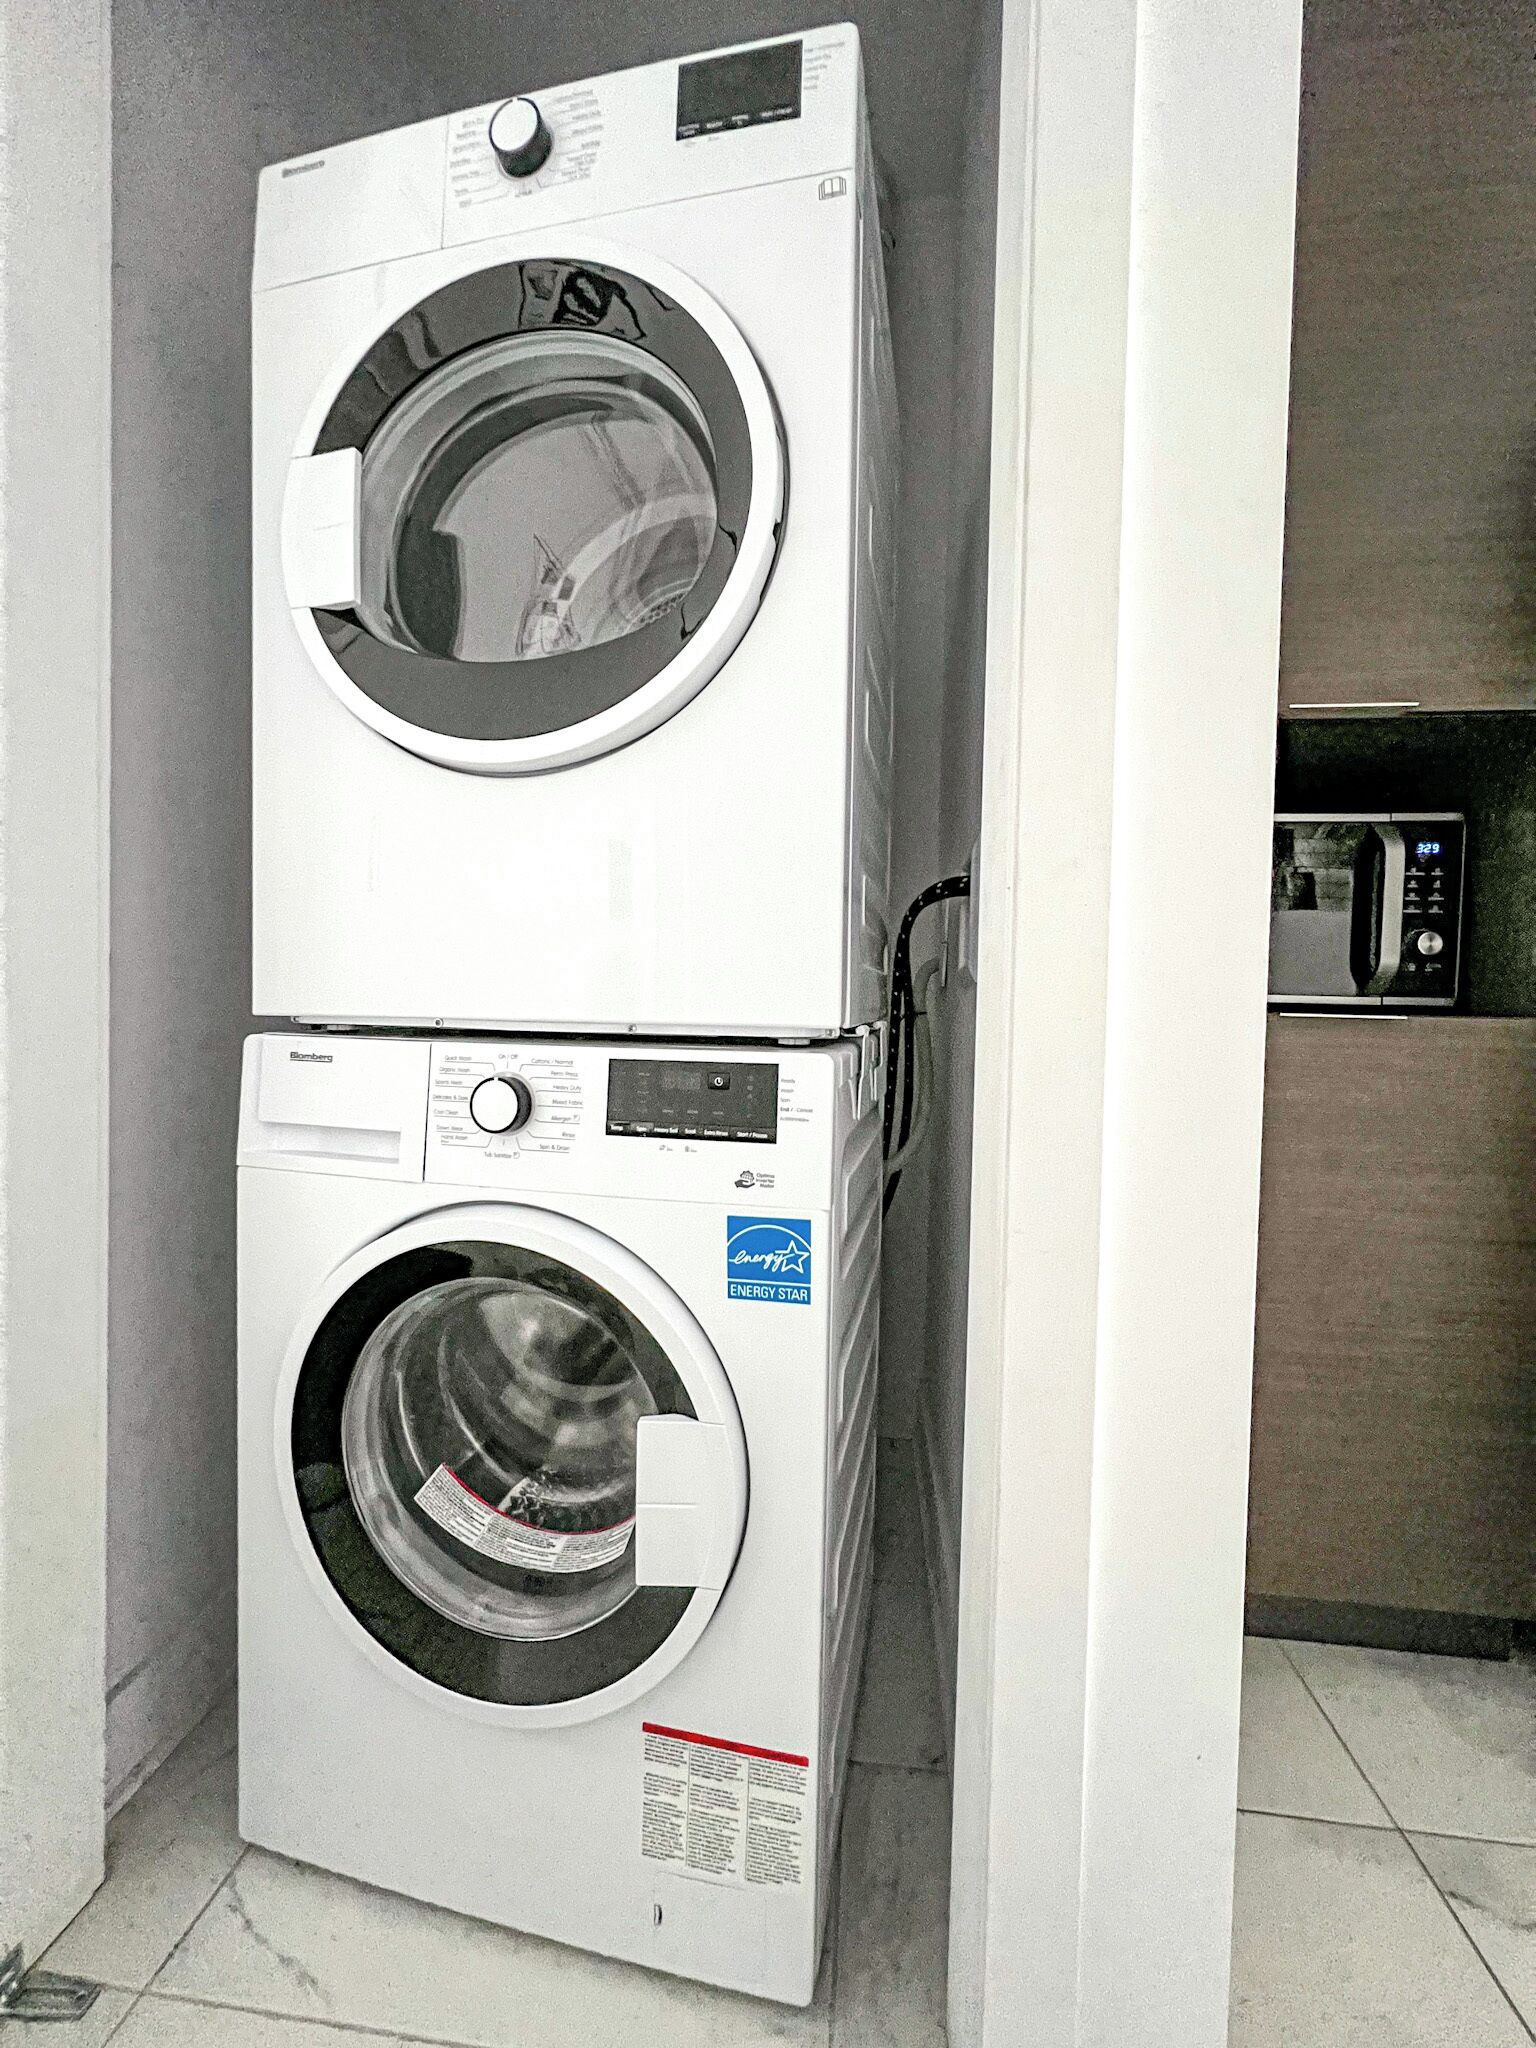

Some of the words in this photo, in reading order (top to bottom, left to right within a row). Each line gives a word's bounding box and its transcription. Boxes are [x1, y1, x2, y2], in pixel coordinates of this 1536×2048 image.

[290, 1051, 333, 1063] Blomberg
[729, 1249, 793, 1272] energy
[730, 1283, 775, 1298] ENERGY
[778, 1288, 808, 1302] STAR
